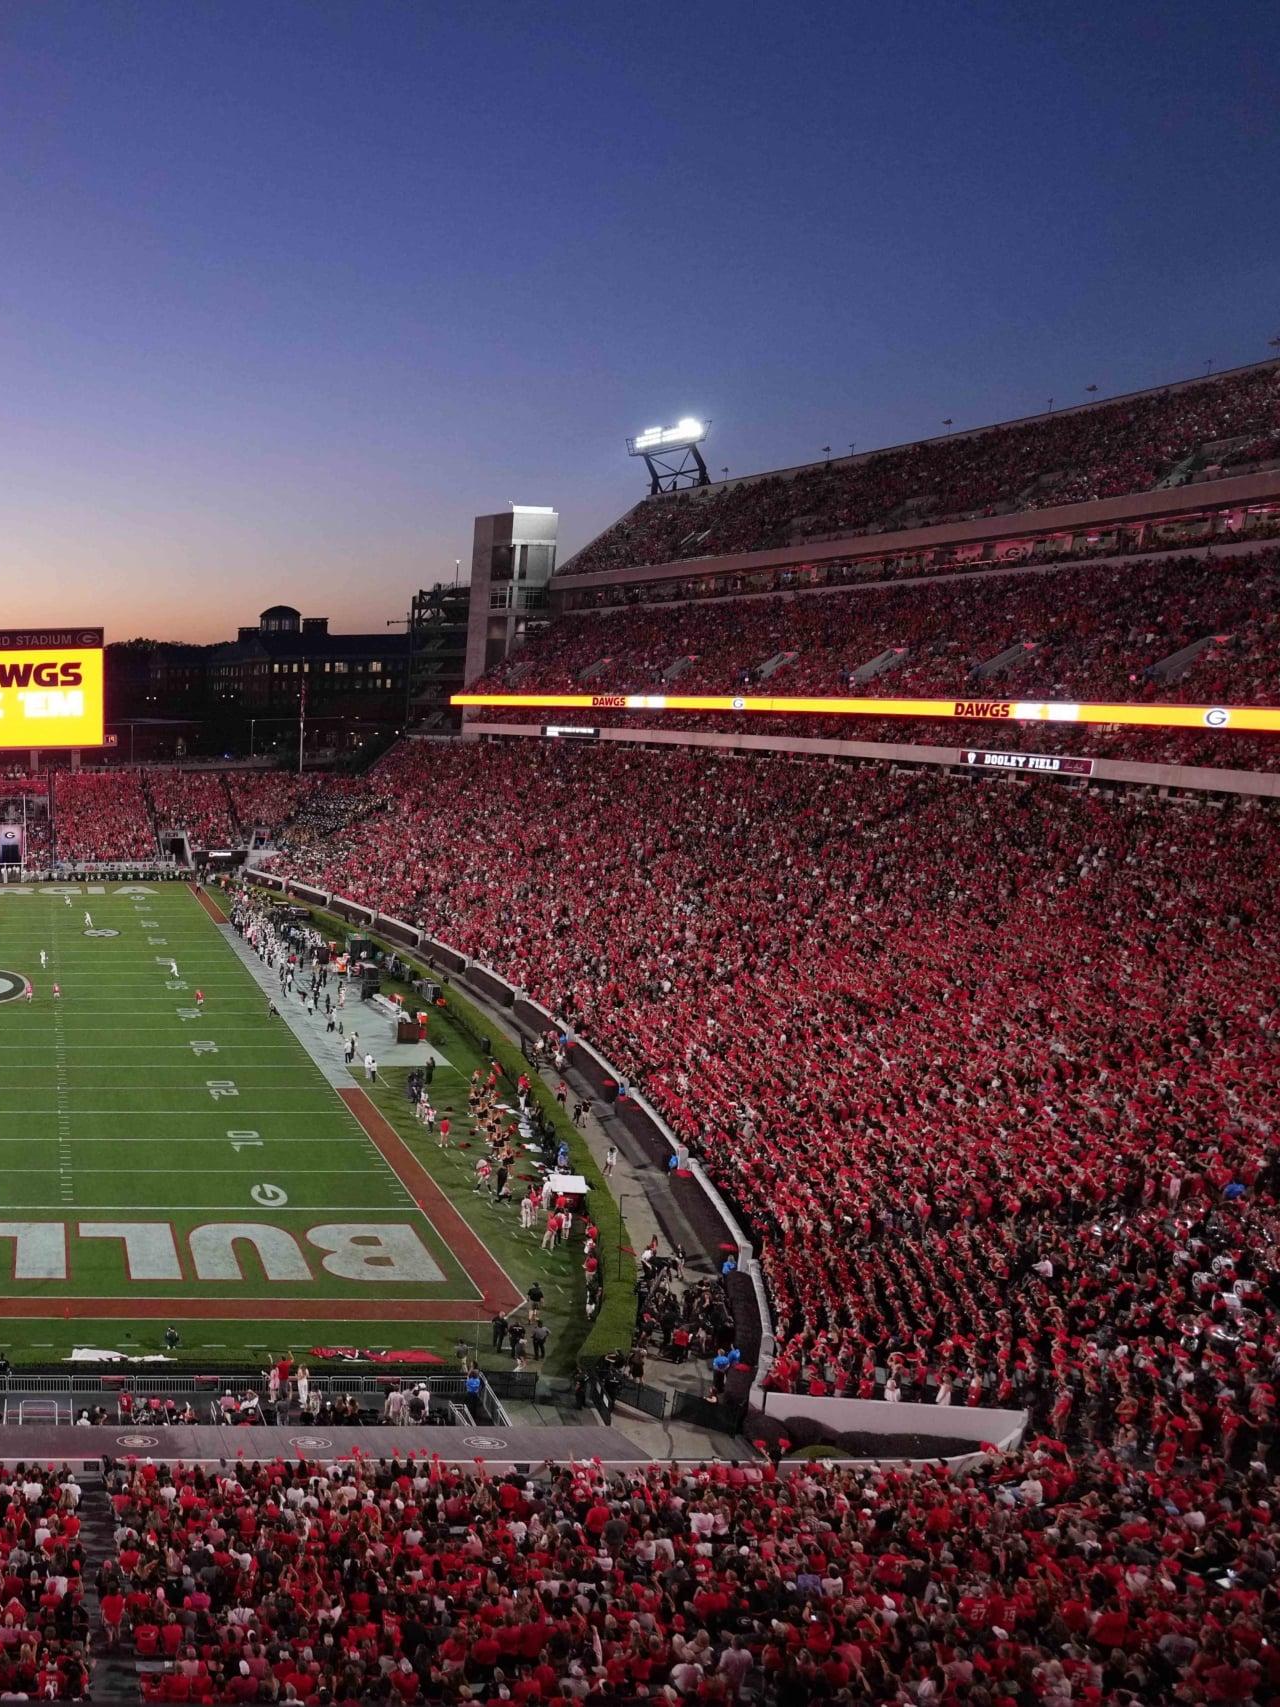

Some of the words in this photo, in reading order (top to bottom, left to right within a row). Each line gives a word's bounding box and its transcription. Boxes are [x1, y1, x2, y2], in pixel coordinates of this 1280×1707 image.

[16, 634, 72, 646] STADIUM
[592, 697, 625, 707] DAWGS
[954, 702, 1009, 718] DAWGS
[984, 753, 1026, 767] DOOLEY
[1028, 757, 1061, 770] FIELD
[190, 1040, 219, 1053] 30
[206, 1080, 240, 1096] 20
[227, 1130, 264, 1147] 10
[971, 1609, 985, 1621] 27
